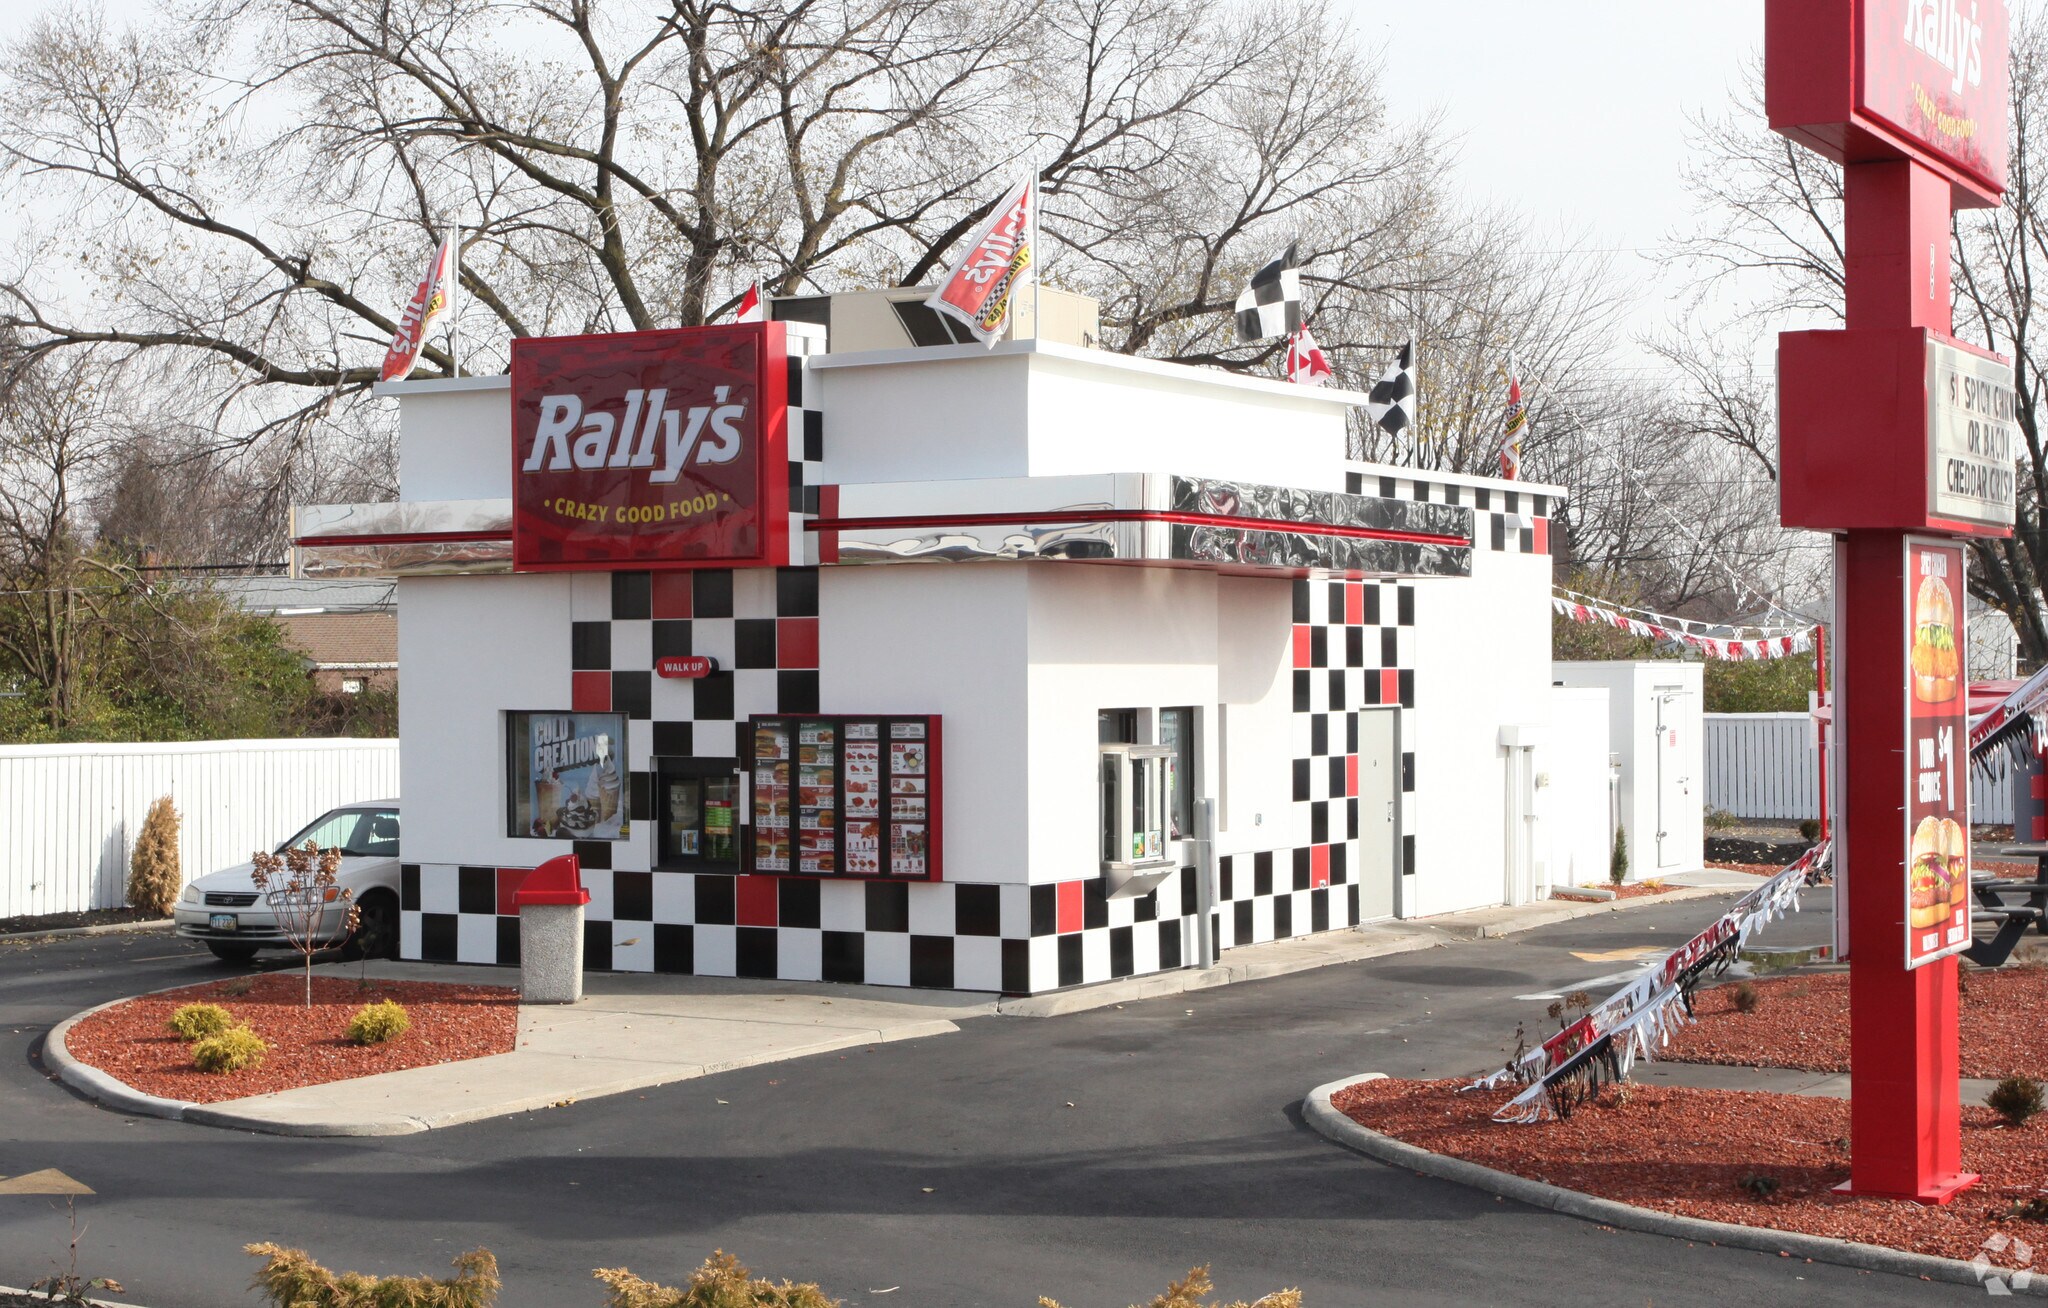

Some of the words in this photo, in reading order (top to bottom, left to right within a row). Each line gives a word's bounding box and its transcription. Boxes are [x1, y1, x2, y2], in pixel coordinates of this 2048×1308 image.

[1903, 0, 1982, 96] Rally's
[1915, 84, 1937, 122] CRAZY
[1937, 109, 1956, 136] GOOD
[1956, 117, 1974, 138] FOOD
[1950, 372, 1960, 407] $1
[1964, 376, 1991, 415] SPICY
[522, 385, 747, 484] Rally's
[1968, 420, 1980, 454] OR
[1984, 424, 2010, 462] BACON
[1947, 458, 1987, 498] CHEDDAR
[1990, 467, 2013, 502] CRISP
[554, 497, 609, 522] CRAZY
[616, 504, 665, 523] GOOD
[670, 492, 718, 519] FOOD
[664, 663, 689, 672] WALK
[691, 663, 703, 671] UP
[534, 717, 569, 746] COLD
[1919, 771, 1942, 803] CHOICE
[1938, 726, 1955, 811] $1
